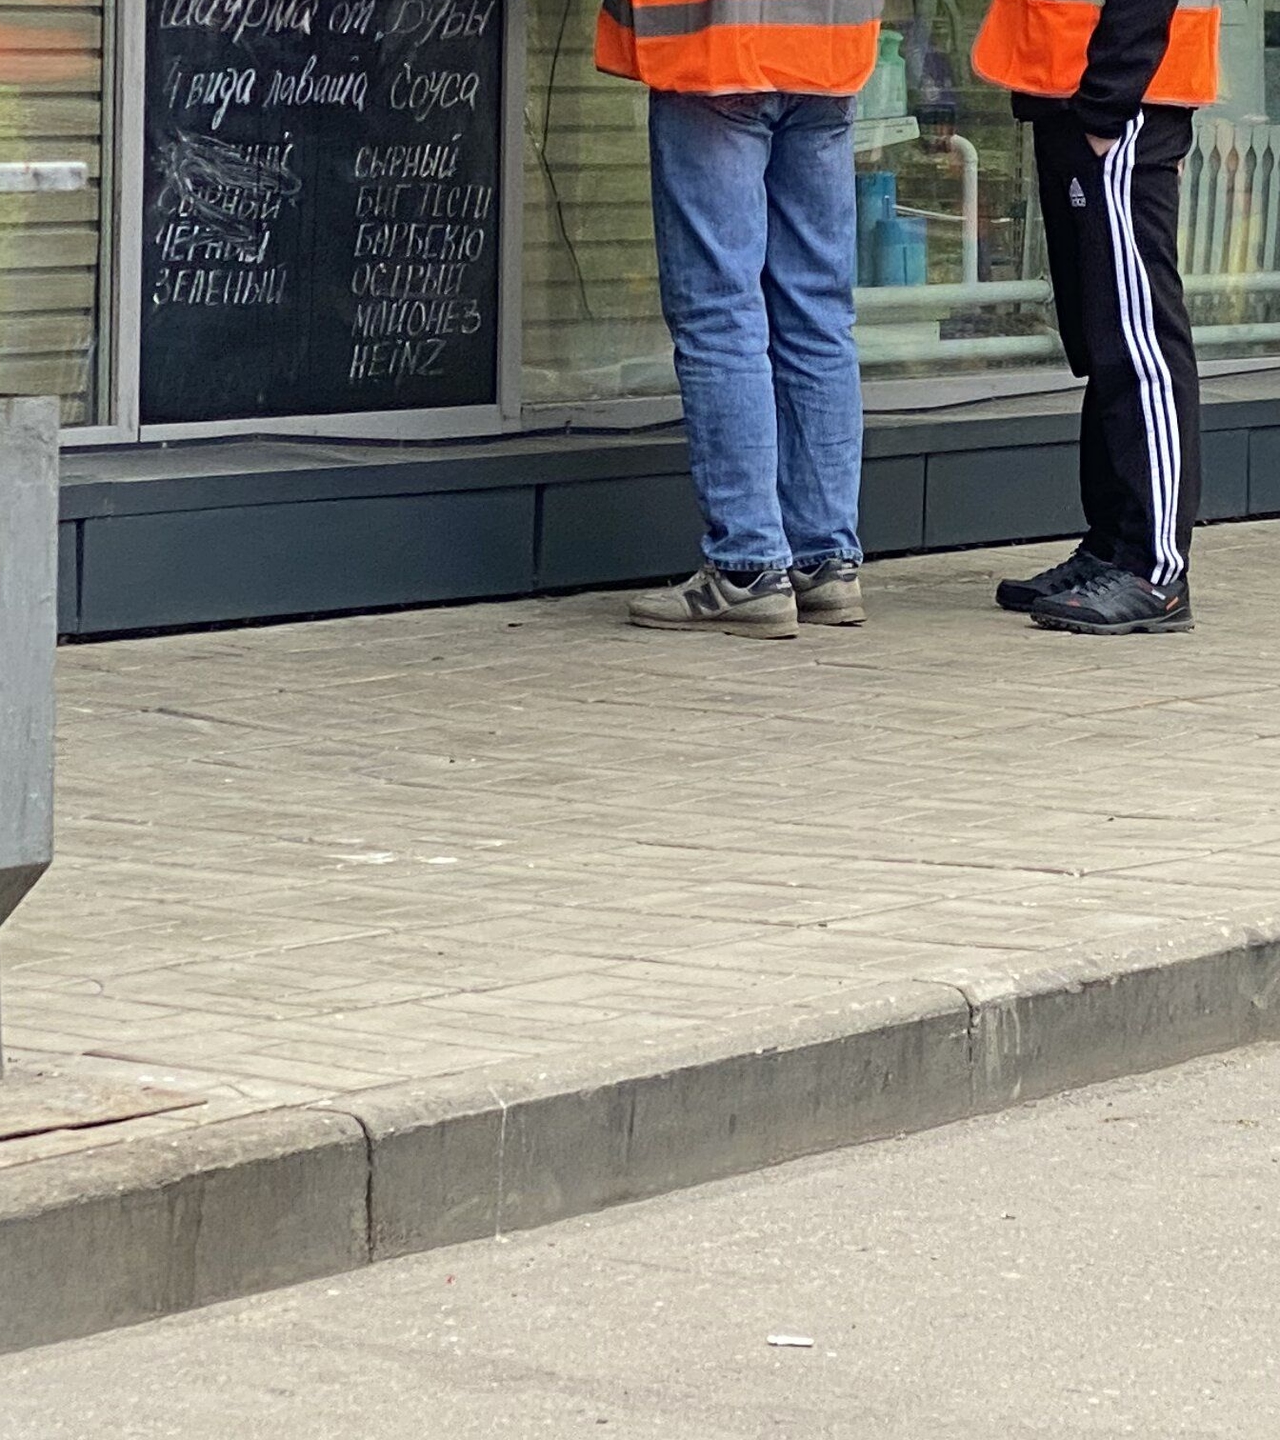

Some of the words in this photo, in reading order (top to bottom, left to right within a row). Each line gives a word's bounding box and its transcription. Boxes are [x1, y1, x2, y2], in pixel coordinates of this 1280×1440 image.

[185, 68, 257, 130] вида
[262, 54, 369, 112] лаваша
[355, 133, 463, 179] СЫРНЫЙ
[356, 183, 412, 219] БИГ
[354, 222, 485, 261] БАРБЕКЮ
[352, 299, 482, 336] МАЙОНЕЗ
